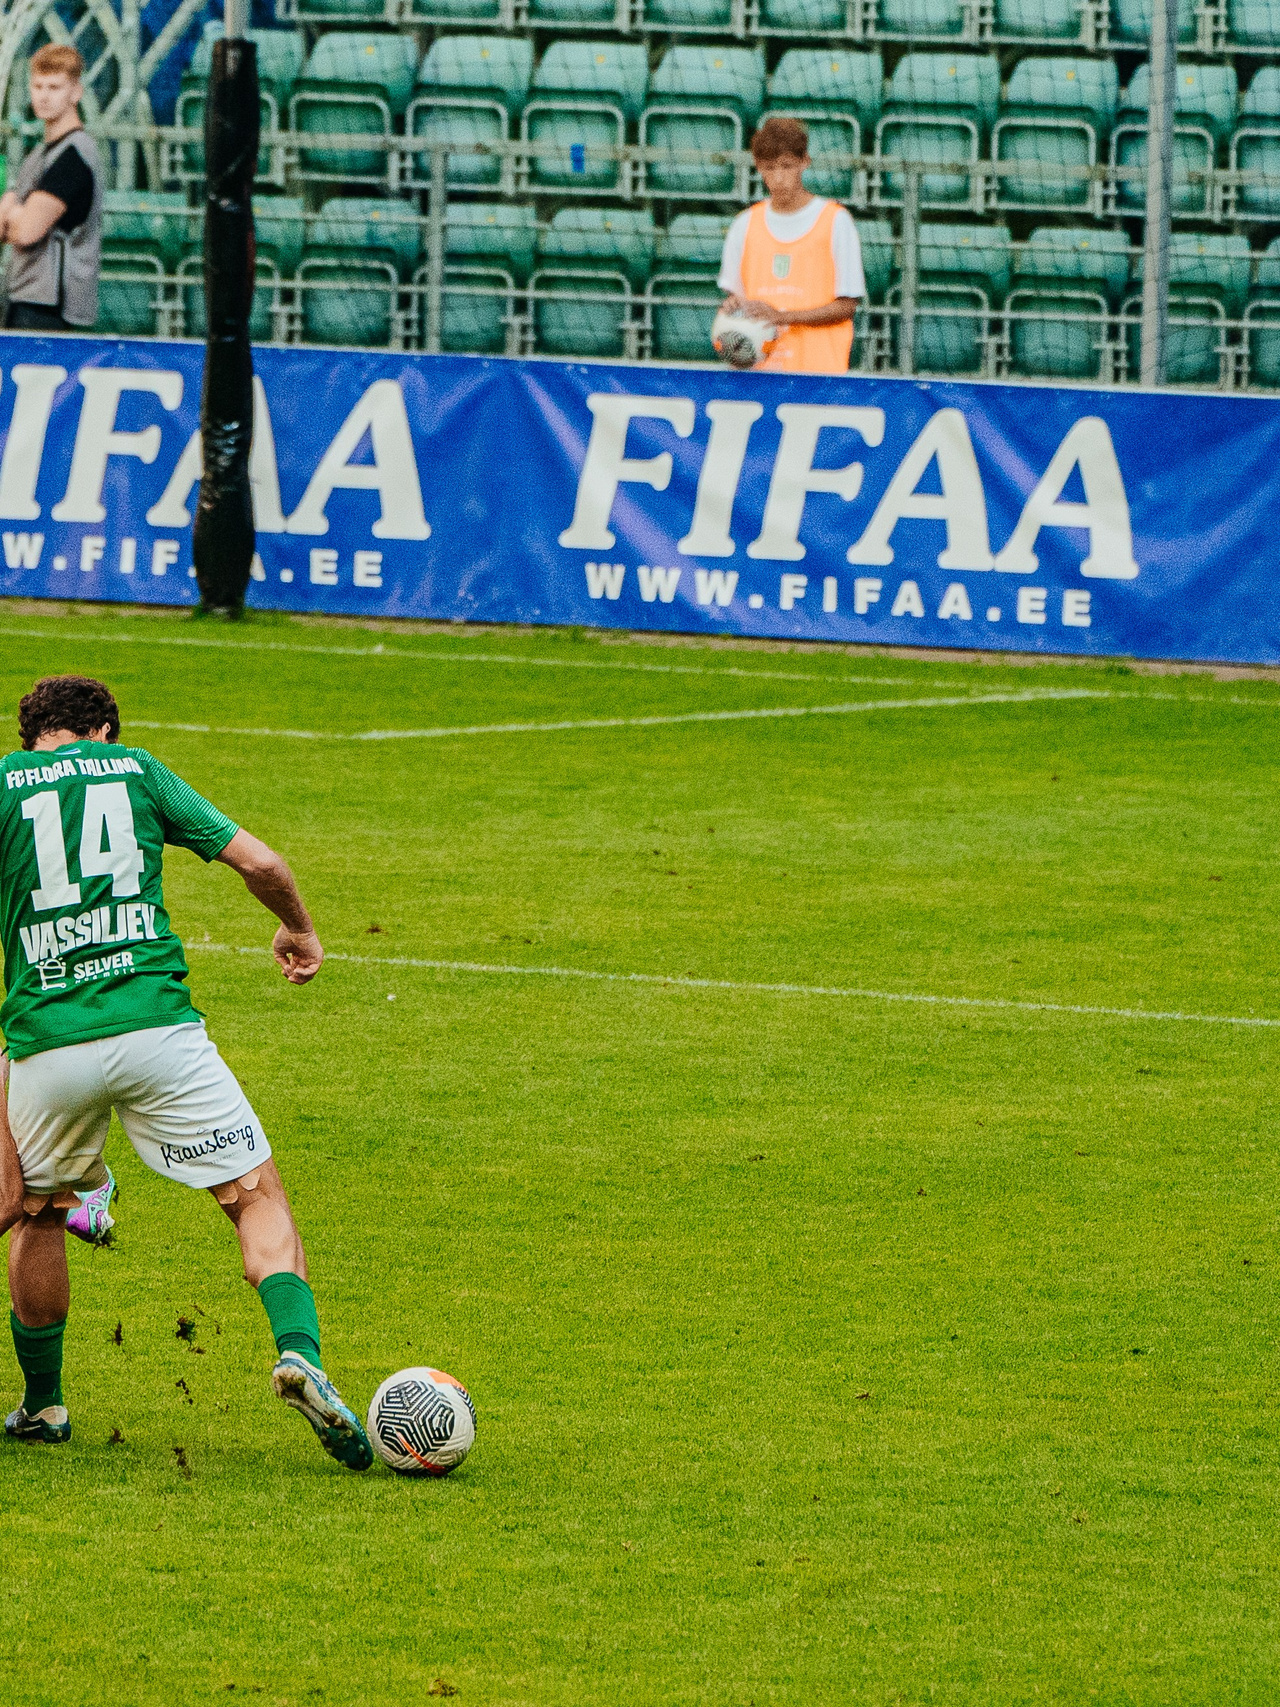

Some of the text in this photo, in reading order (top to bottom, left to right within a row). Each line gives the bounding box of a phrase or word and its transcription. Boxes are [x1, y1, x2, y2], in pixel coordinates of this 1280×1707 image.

[558, 394, 1139, 579] FIFAA
[585, 563, 1092, 627] WWW.FIFAA.EE
[5, 757, 144, 790] FC FLORA TALLINN
[21, 781, 145, 912] 14
[19, 902, 158, 965] VASSILJEV
[73, 951, 134, 979] SELVER
[160, 1124, 255, 1169] Krausberg
